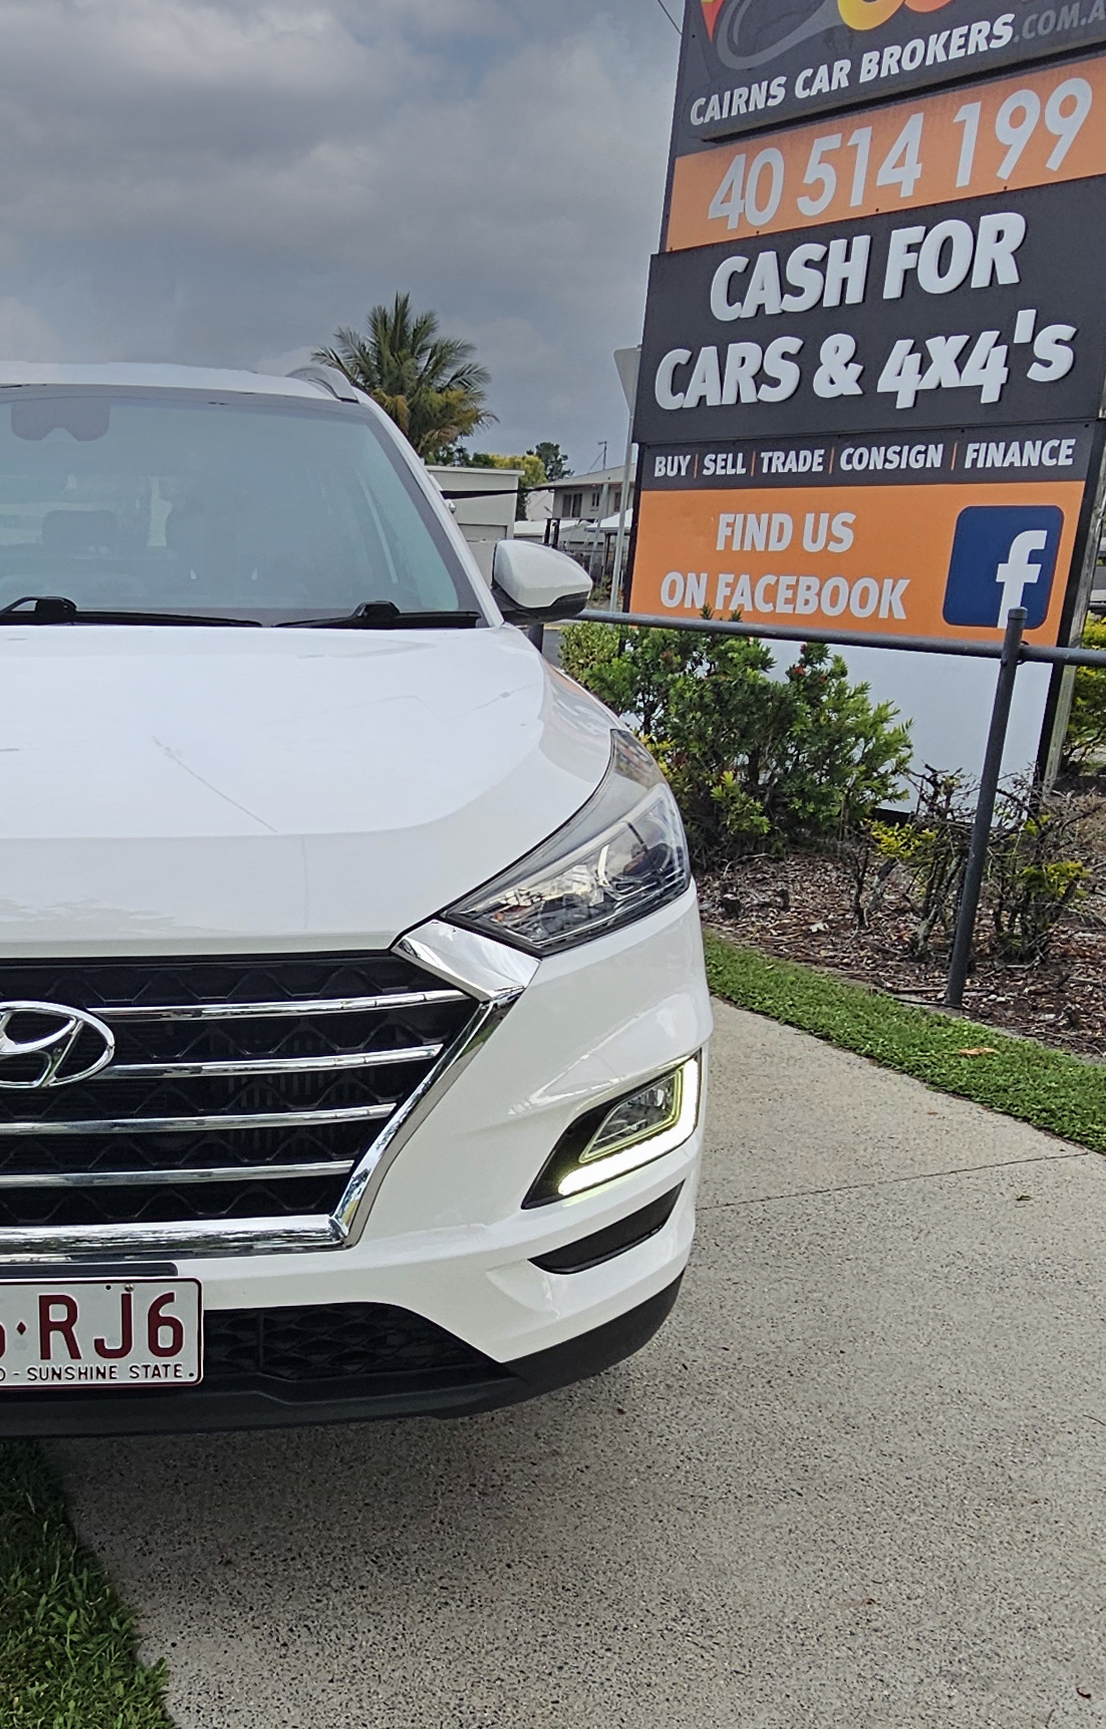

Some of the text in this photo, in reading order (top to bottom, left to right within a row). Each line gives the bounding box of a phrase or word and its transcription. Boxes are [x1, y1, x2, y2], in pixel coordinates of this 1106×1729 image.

[690, 76, 786, 126] CAIRNS
[795, 59, 850, 100] CAR
[707, 77, 1093, 230] 40 514 199
[710, 212, 1026, 321] CASH FOR
[655, 336, 804, 411] CARS
[813, 333, 864, 398] &
[654, 438, 1076, 478] BUY SELL TRADE CONSIGN FINANCE
[716, 512, 856, 553] FIND US
[660, 572, 911, 620] ON FACEBOOK
[27, 1365, 119, 1381] SUNSHINE
[129, 1363, 184, 1379] STATE
